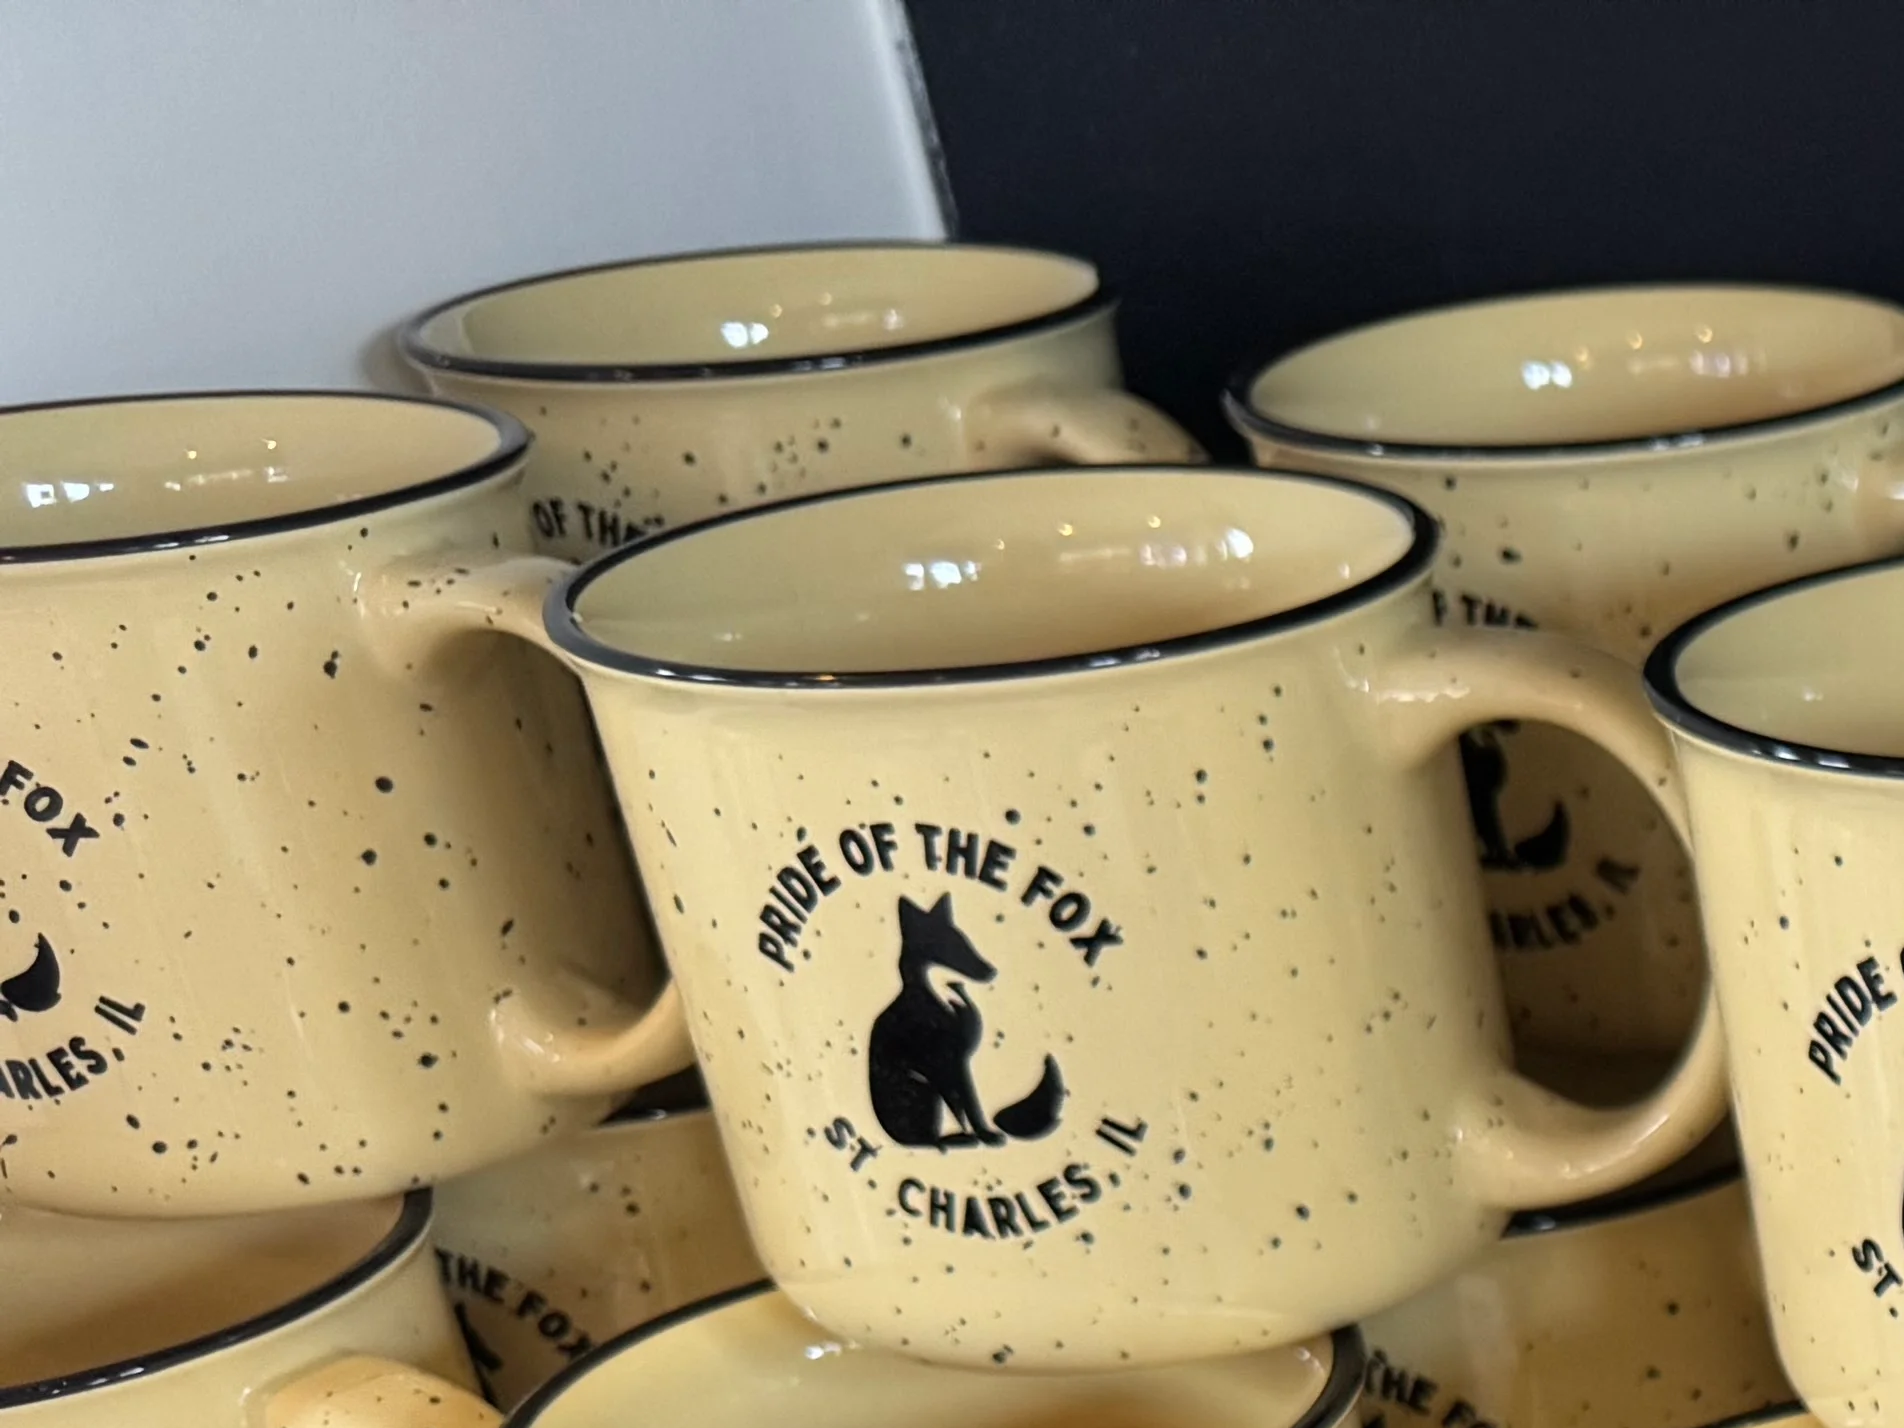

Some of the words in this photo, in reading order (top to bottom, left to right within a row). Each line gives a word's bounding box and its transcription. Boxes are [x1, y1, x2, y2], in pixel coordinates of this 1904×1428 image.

[0, 760, 100, 857] FOX
[758, 844, 841, 973] PRIDE
[839, 823, 898, 876] OF
[915, 823, 1017, 891] THE
[1020, 866, 1124, 967] FOX
[94, 995, 146, 1035] IL
[1808, 956, 1897, 1085] PRIDE
[1096, 1113, 1149, 1157] IL
